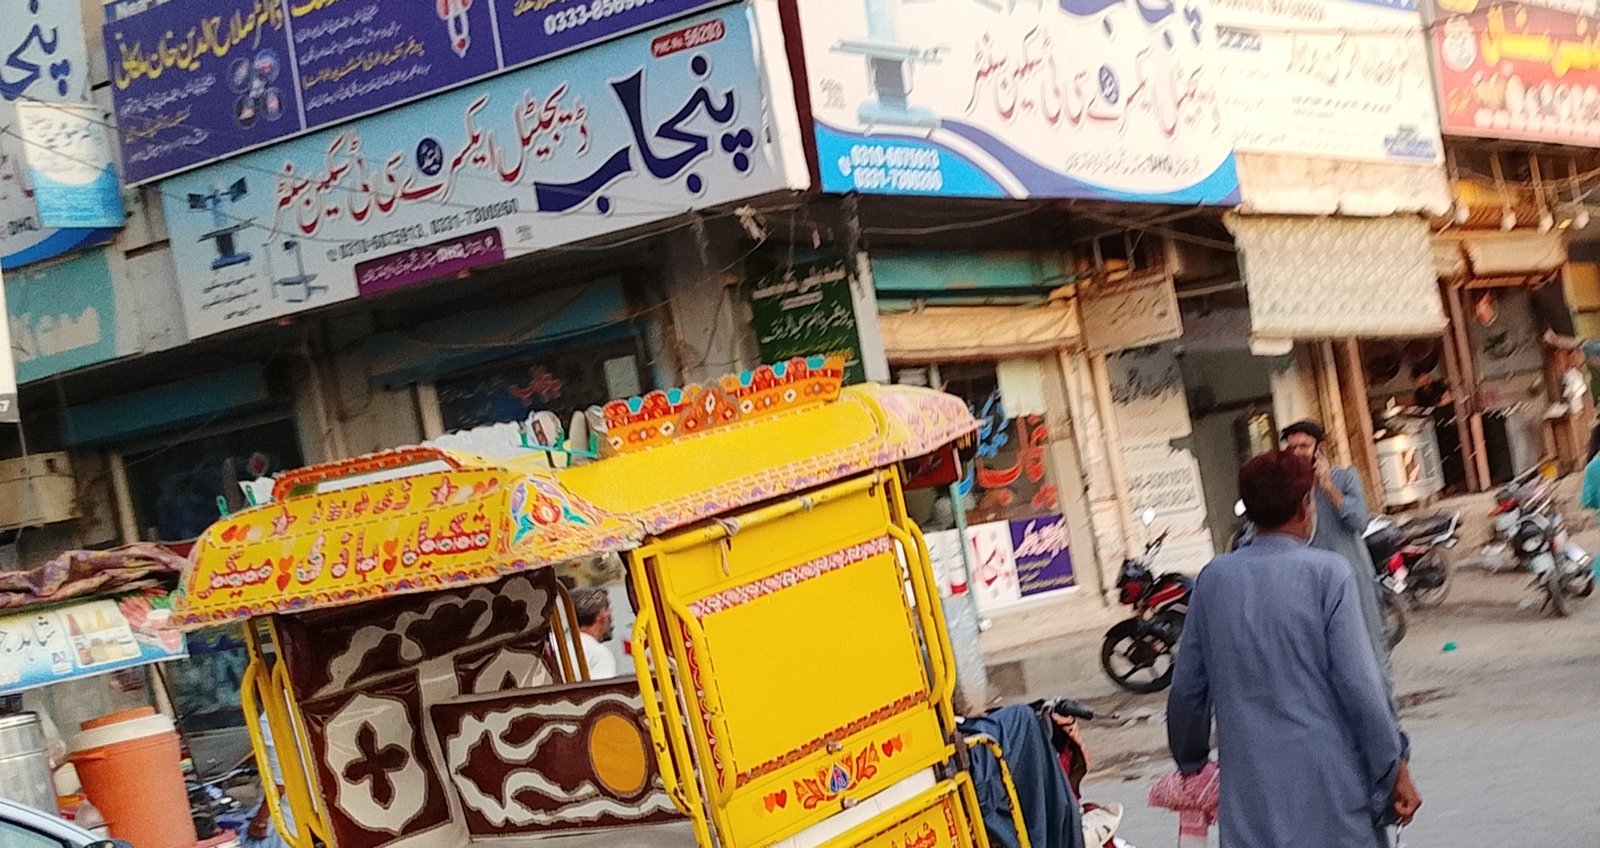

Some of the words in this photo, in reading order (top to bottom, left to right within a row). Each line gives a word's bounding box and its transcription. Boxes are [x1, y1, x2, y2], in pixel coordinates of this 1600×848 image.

[499, 83, 590, 184] ڈیجیٹل
[534, 54, 755, 214] پنجاب
[197, 551, 274, 600] میکر
